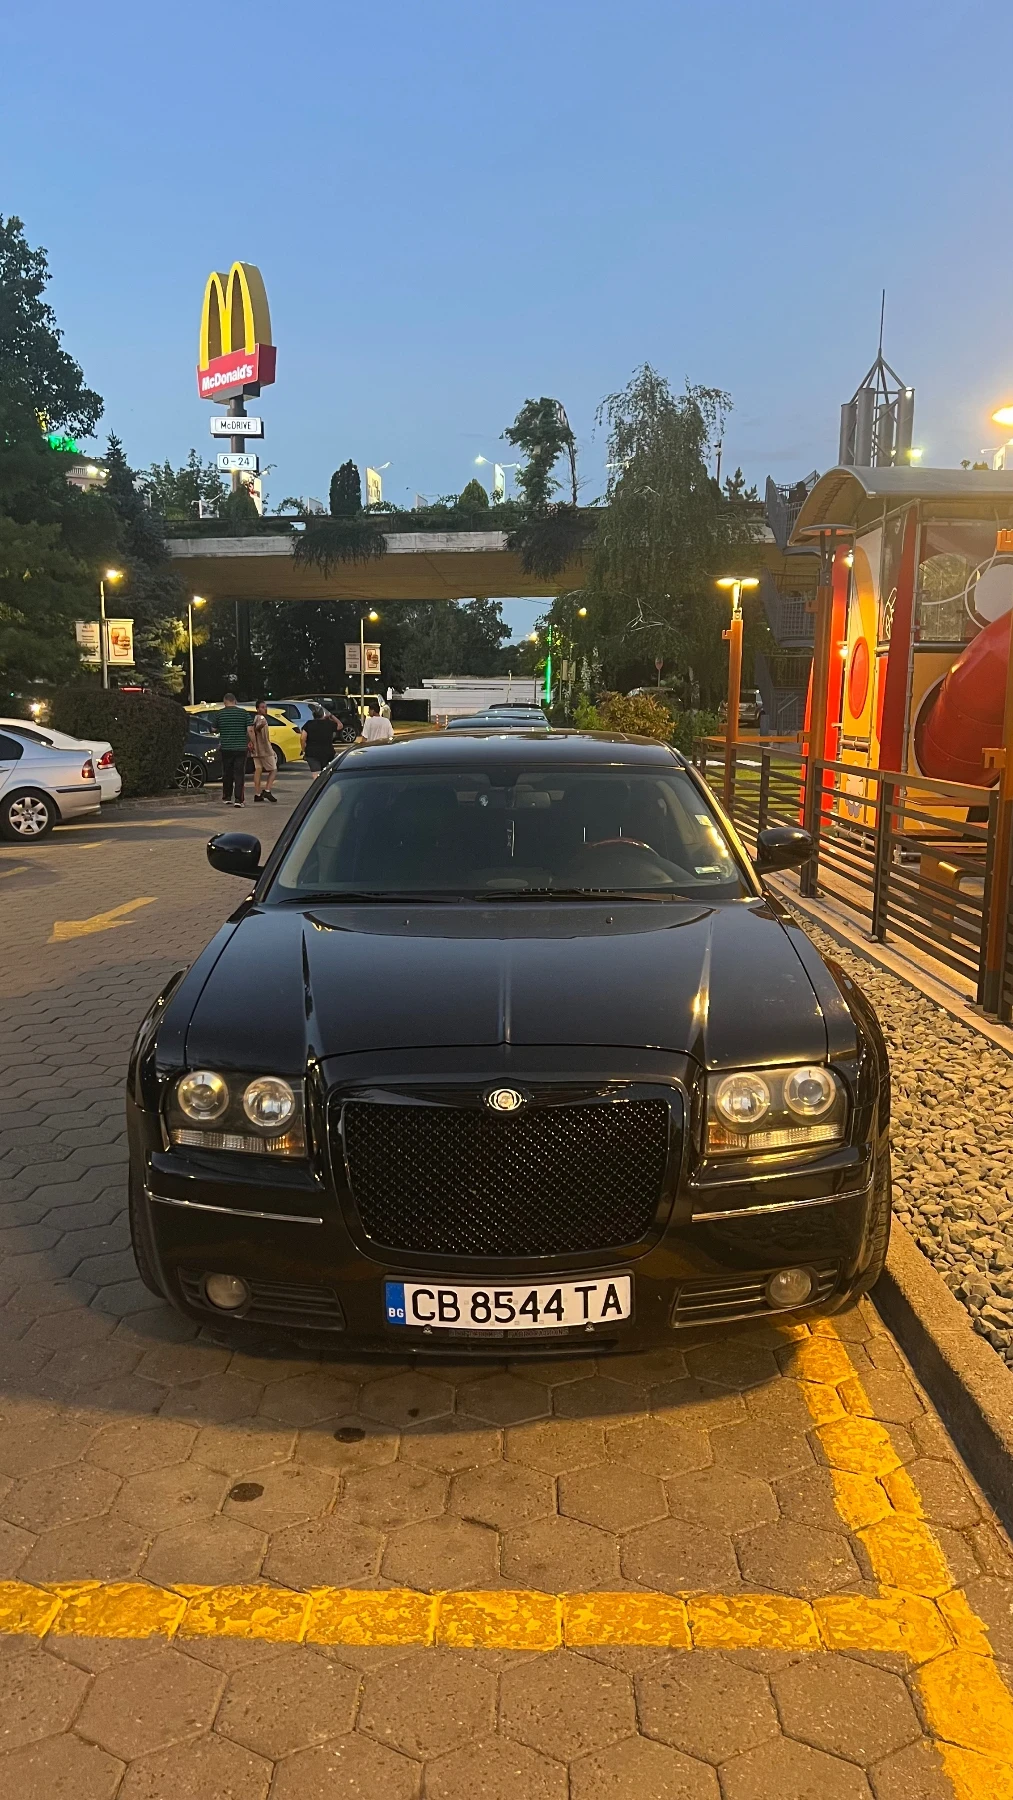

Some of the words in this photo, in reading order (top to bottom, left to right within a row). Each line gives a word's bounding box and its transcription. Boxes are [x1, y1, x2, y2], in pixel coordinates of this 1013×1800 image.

[202, 364, 253, 391] McDonald's
[220, 421, 251, 429] McDRIVE
[388, 1307, 404, 1318] BG
[412, 1288, 460, 1322] CB
[470, 1288, 565, 1323] 8544
[574, 1283, 622, 1319] TA
